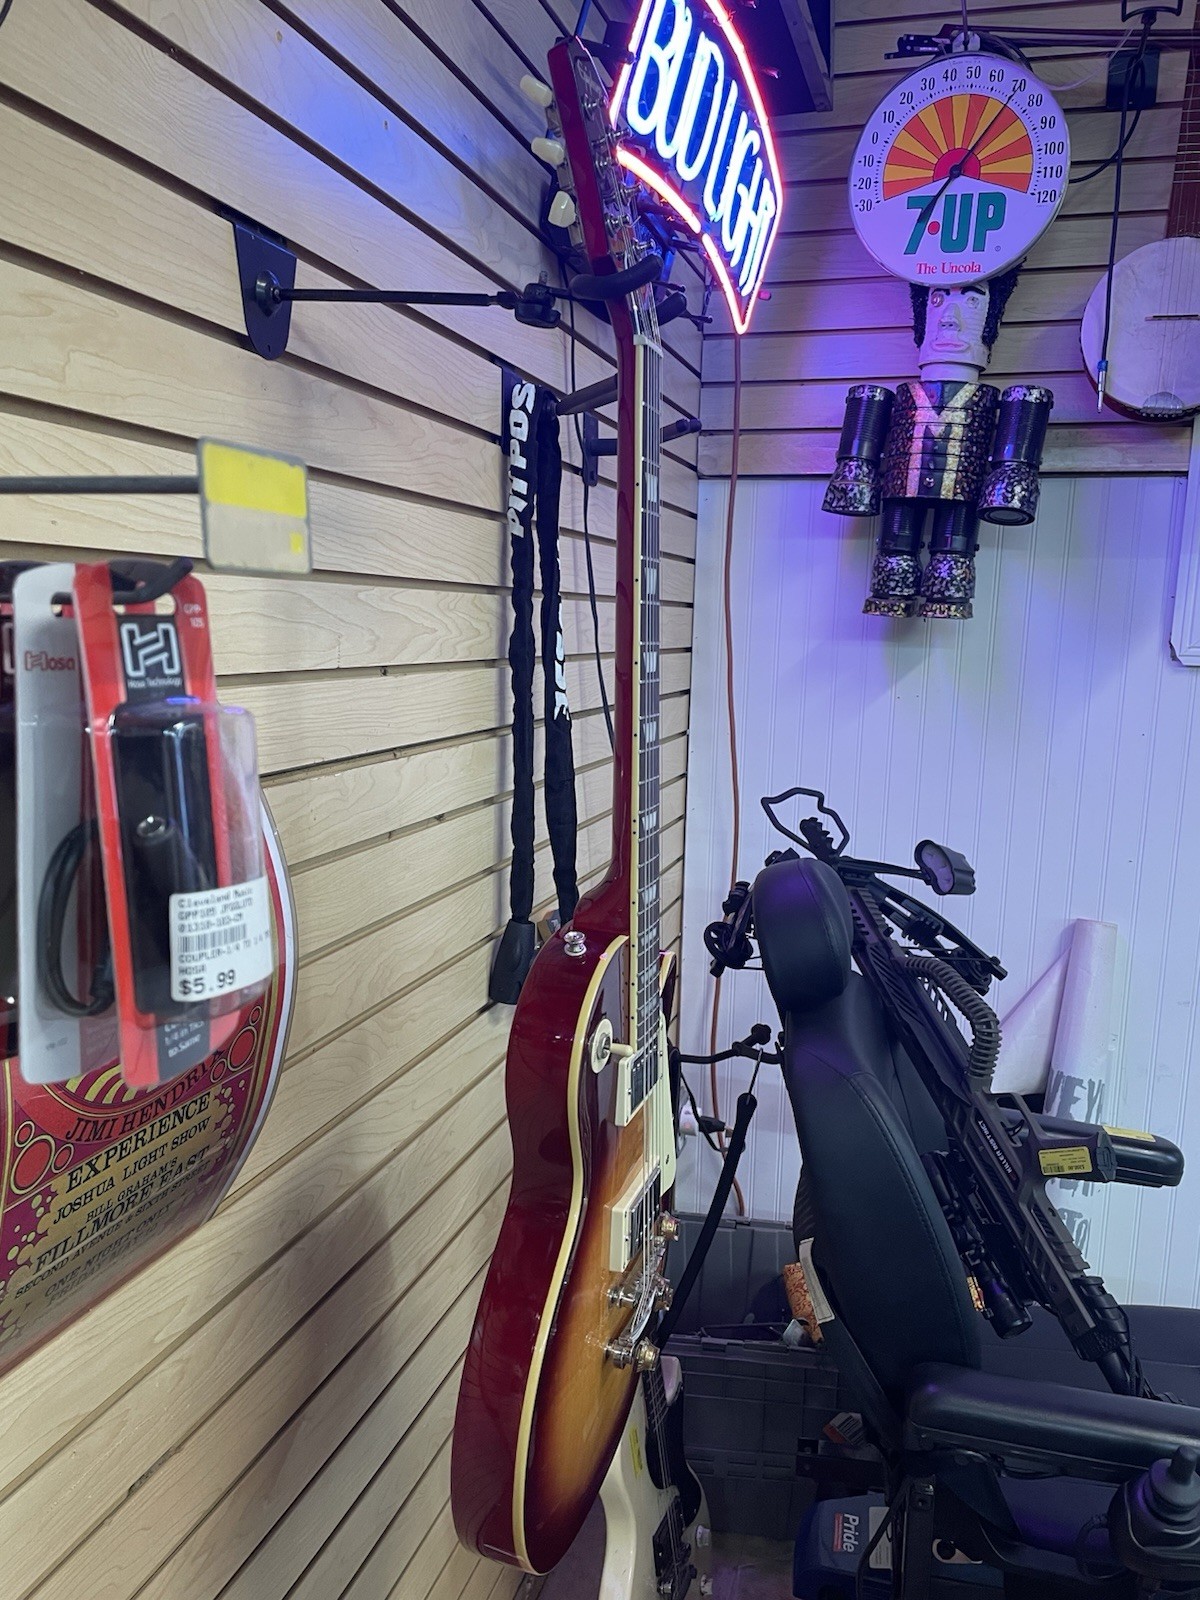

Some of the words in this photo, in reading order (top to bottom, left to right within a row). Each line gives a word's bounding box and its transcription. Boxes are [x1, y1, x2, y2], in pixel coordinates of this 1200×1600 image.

[942, 68, 957, 82] 40
[966, 65, 981, 79] 50
[989, 69, 1004, 82] 60
[920, 77, 936, 91] 30
[1012, 78, 1026, 92] 70
[899, 91, 914, 105] 20
[1027, 93, 1043, 107] 80
[882, 110, 895, 124] 10
[1040, 115, 1056, 129] 90
[871, 131, 879, 144] 0
[1044, 141, 1064, 155] 100
[857, 154, 874, 167] -10
[1043, 165, 1063, 179] 110
[853, 177, 872, 190] -20
[1036, 189, 1057, 204] 120
[854, 199, 873, 212] -30
[916, 262, 938, 275] The
[941, 261, 982, 274] Uncola
[25, 651, 76, 672] Hosa
[179, 969, 236, 996] $5.99
[65, 1115, 116, 1144] JIMI
[64, 1092, 212, 1194] EXPERIENCE
[52, 1176, 117, 1226] JOSHUA
[121, 1143, 170, 1183] LIGHT
[170, 1115, 213, 1151] SHOW
[86, 1198, 114, 1223] BILL
[117, 1156, 179, 1204] GRAHAM'S
[33, 1183, 154, 1276] FILLMORE
[158, 1144, 212, 1192] EAST
[14, 1254, 71, 1300] SECOND
[71, 1219, 125, 1264] AVENUE
[842, 1513, 860, 1553] Pride
